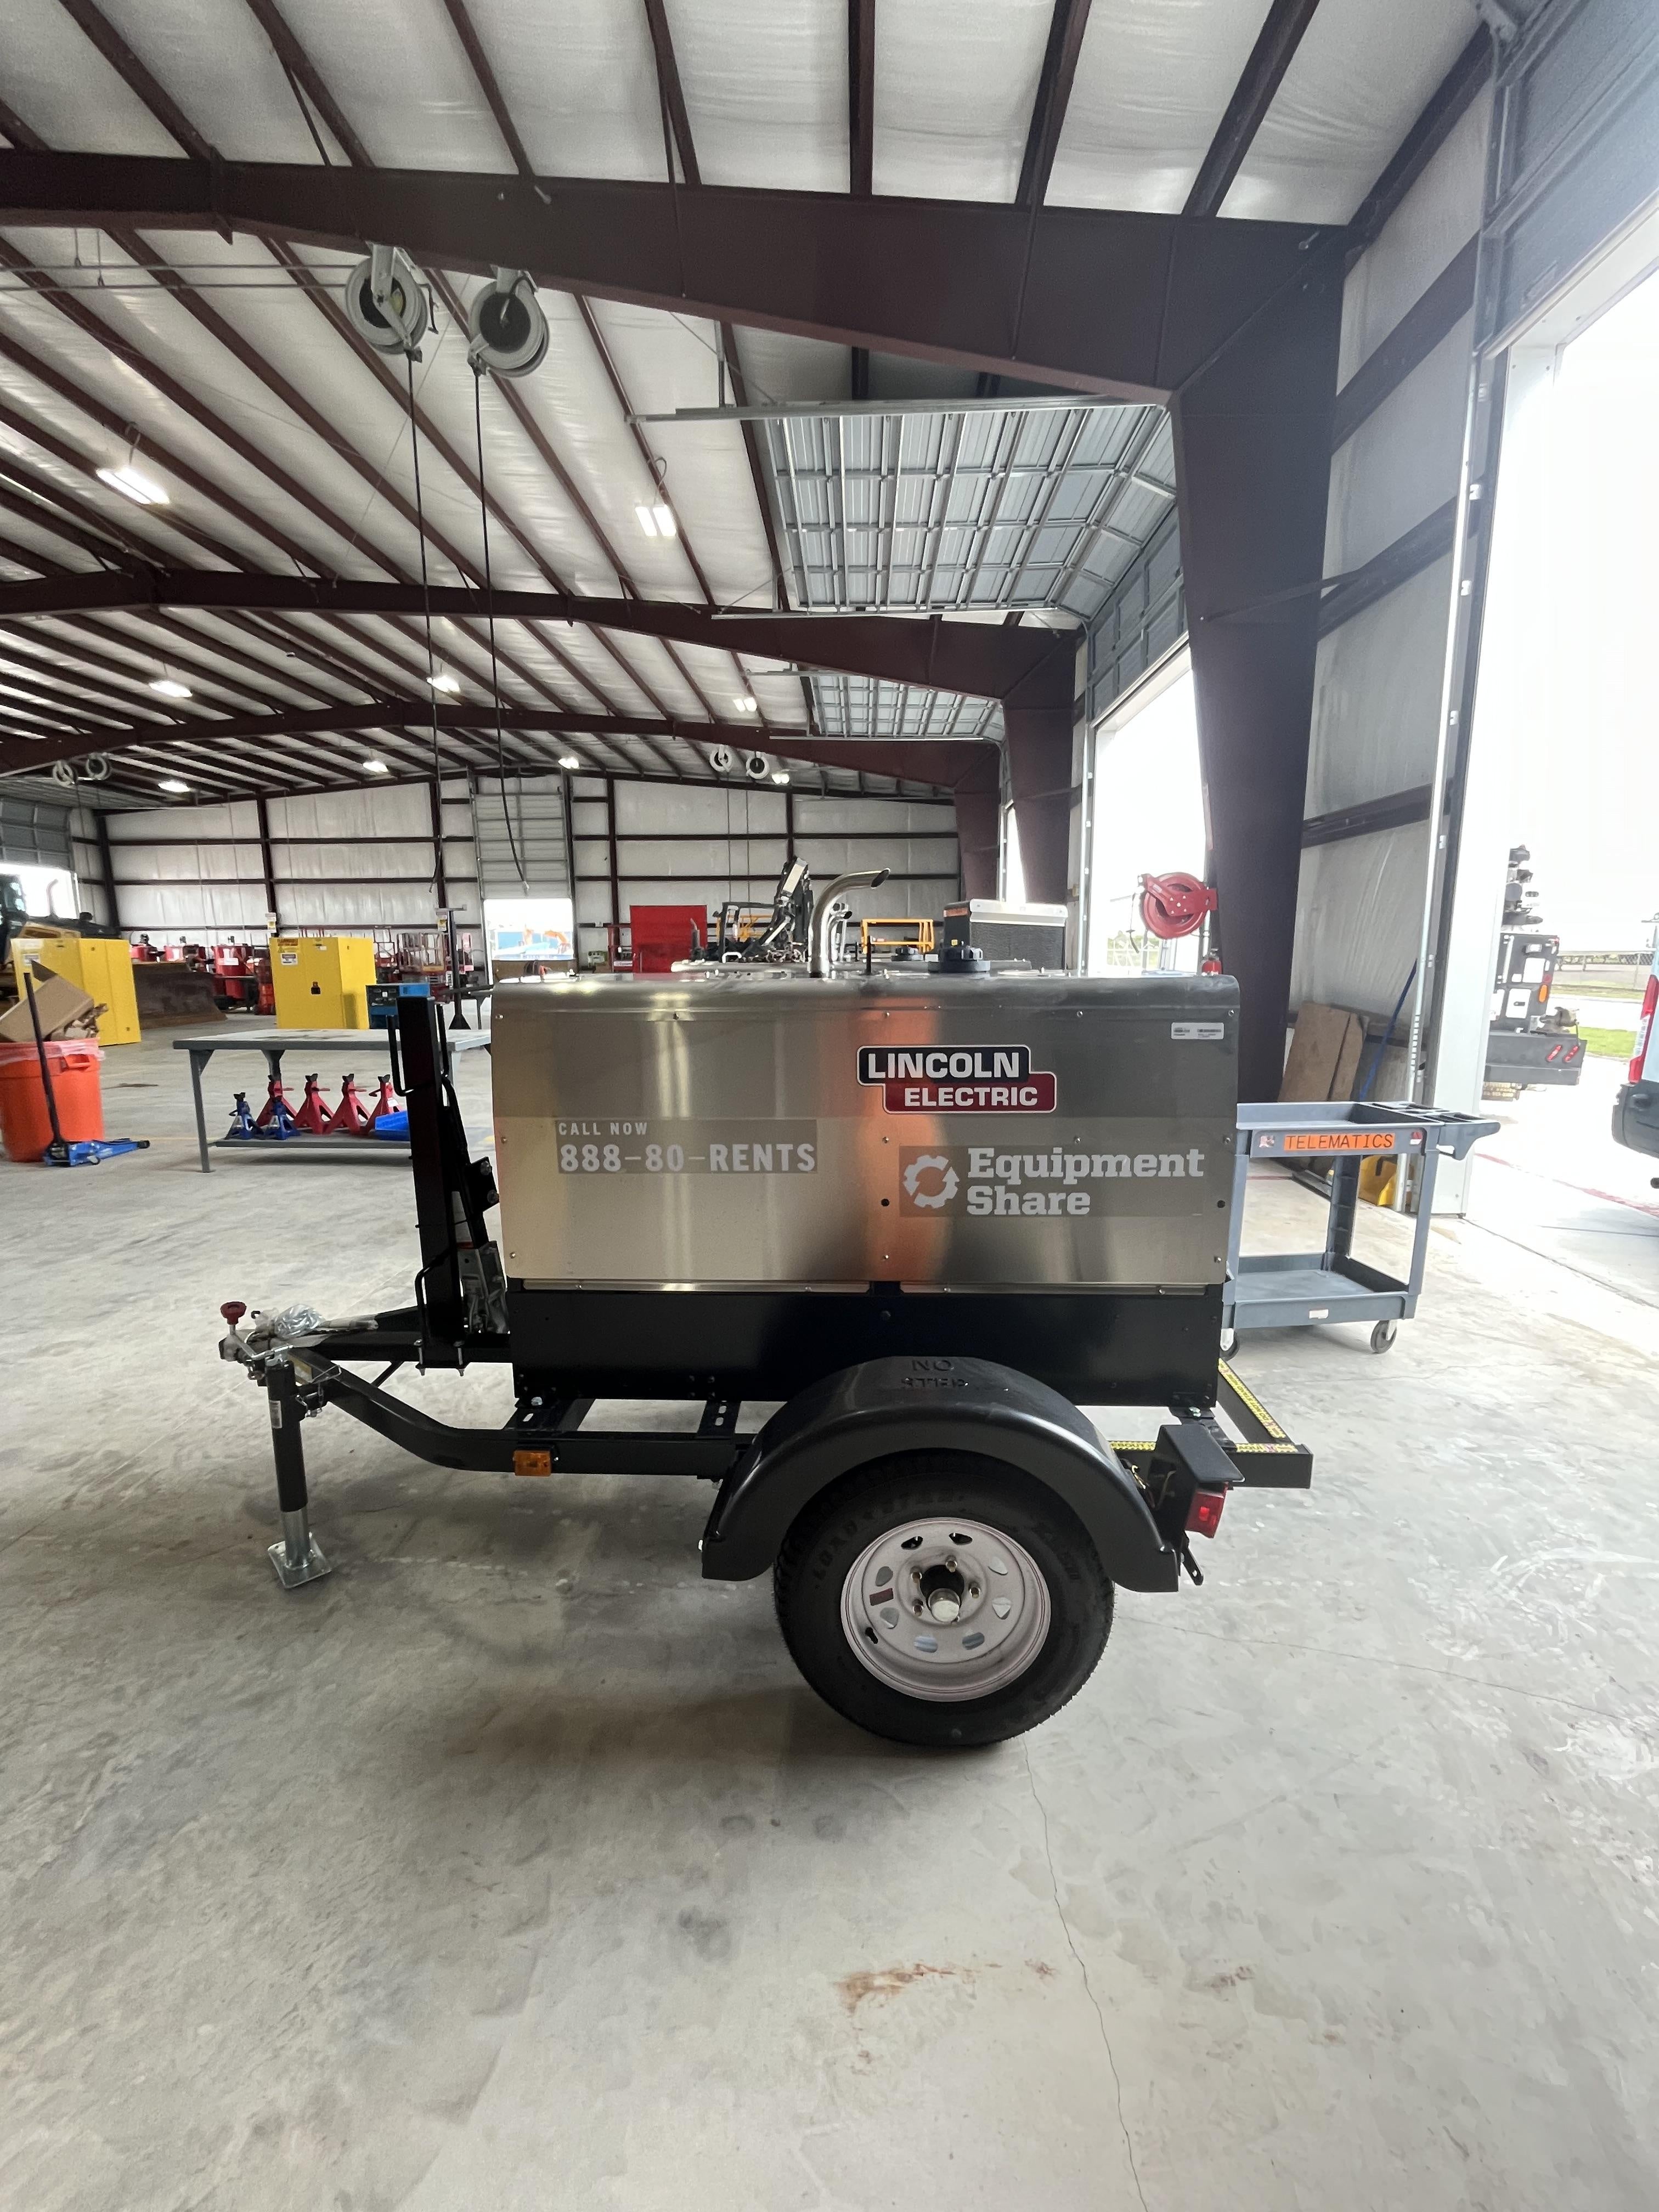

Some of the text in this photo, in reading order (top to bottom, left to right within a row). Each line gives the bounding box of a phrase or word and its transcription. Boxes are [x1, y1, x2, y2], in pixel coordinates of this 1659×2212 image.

[868, 1052, 1019, 1079] LINCOLN
[905, 1087, 1038, 1107] ELECTRIC
[558, 1122, 648, 1136] CALL NOW
[1286, 1133, 1393, 1150] TELEMATICS
[560, 1143, 815, 1172] 888-80-RENTS
[967, 1147, 1205, 1185] Equipment
[967, 1185, 1091, 1215] Share
[912, 1359, 952, 1372] NO
